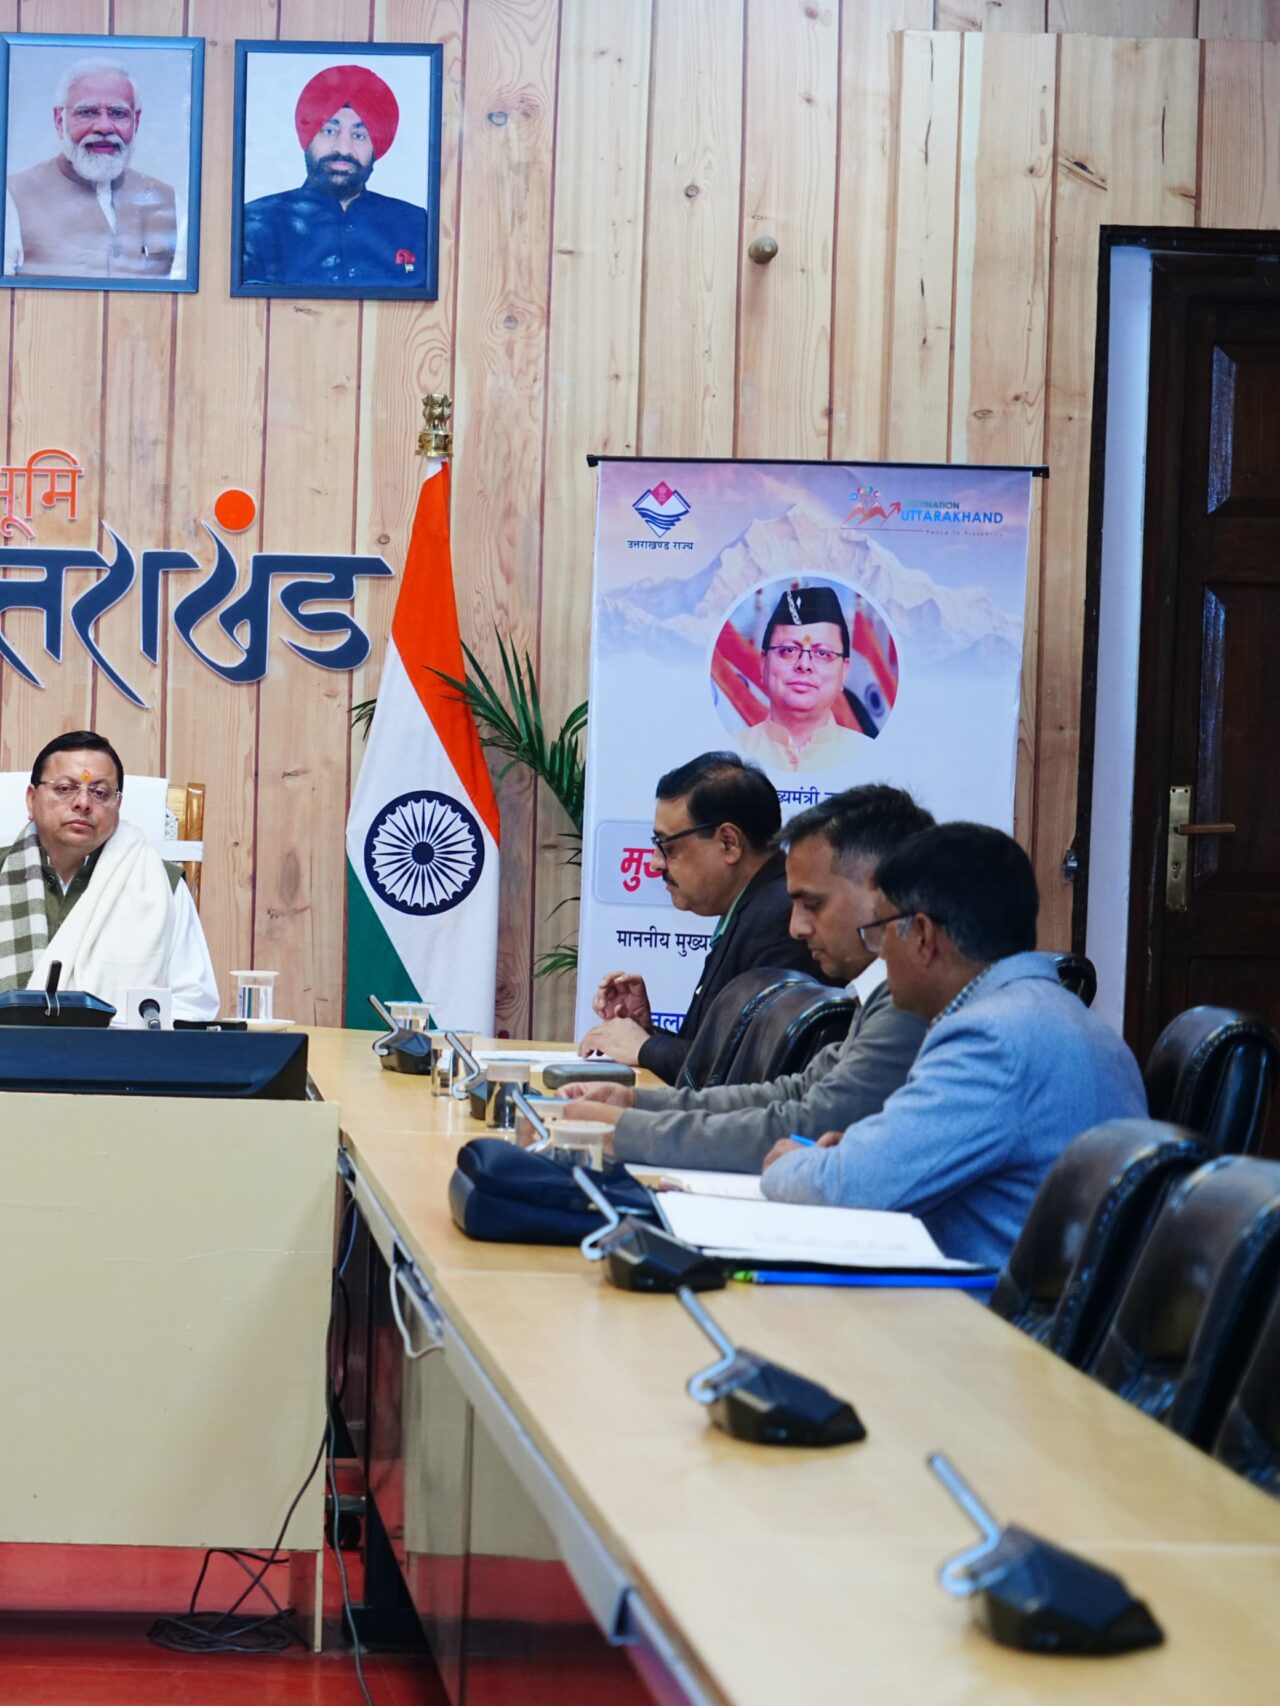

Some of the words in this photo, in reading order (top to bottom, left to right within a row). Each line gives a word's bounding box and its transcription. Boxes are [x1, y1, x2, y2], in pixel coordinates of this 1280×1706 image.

[901, 510, 1004, 524] UTTARAKHAND
[627, 540, 670, 550] उत्तराखण्ड
[672, 541, 694, 551] राज्य
[616, 925, 671, 949] माननीय
